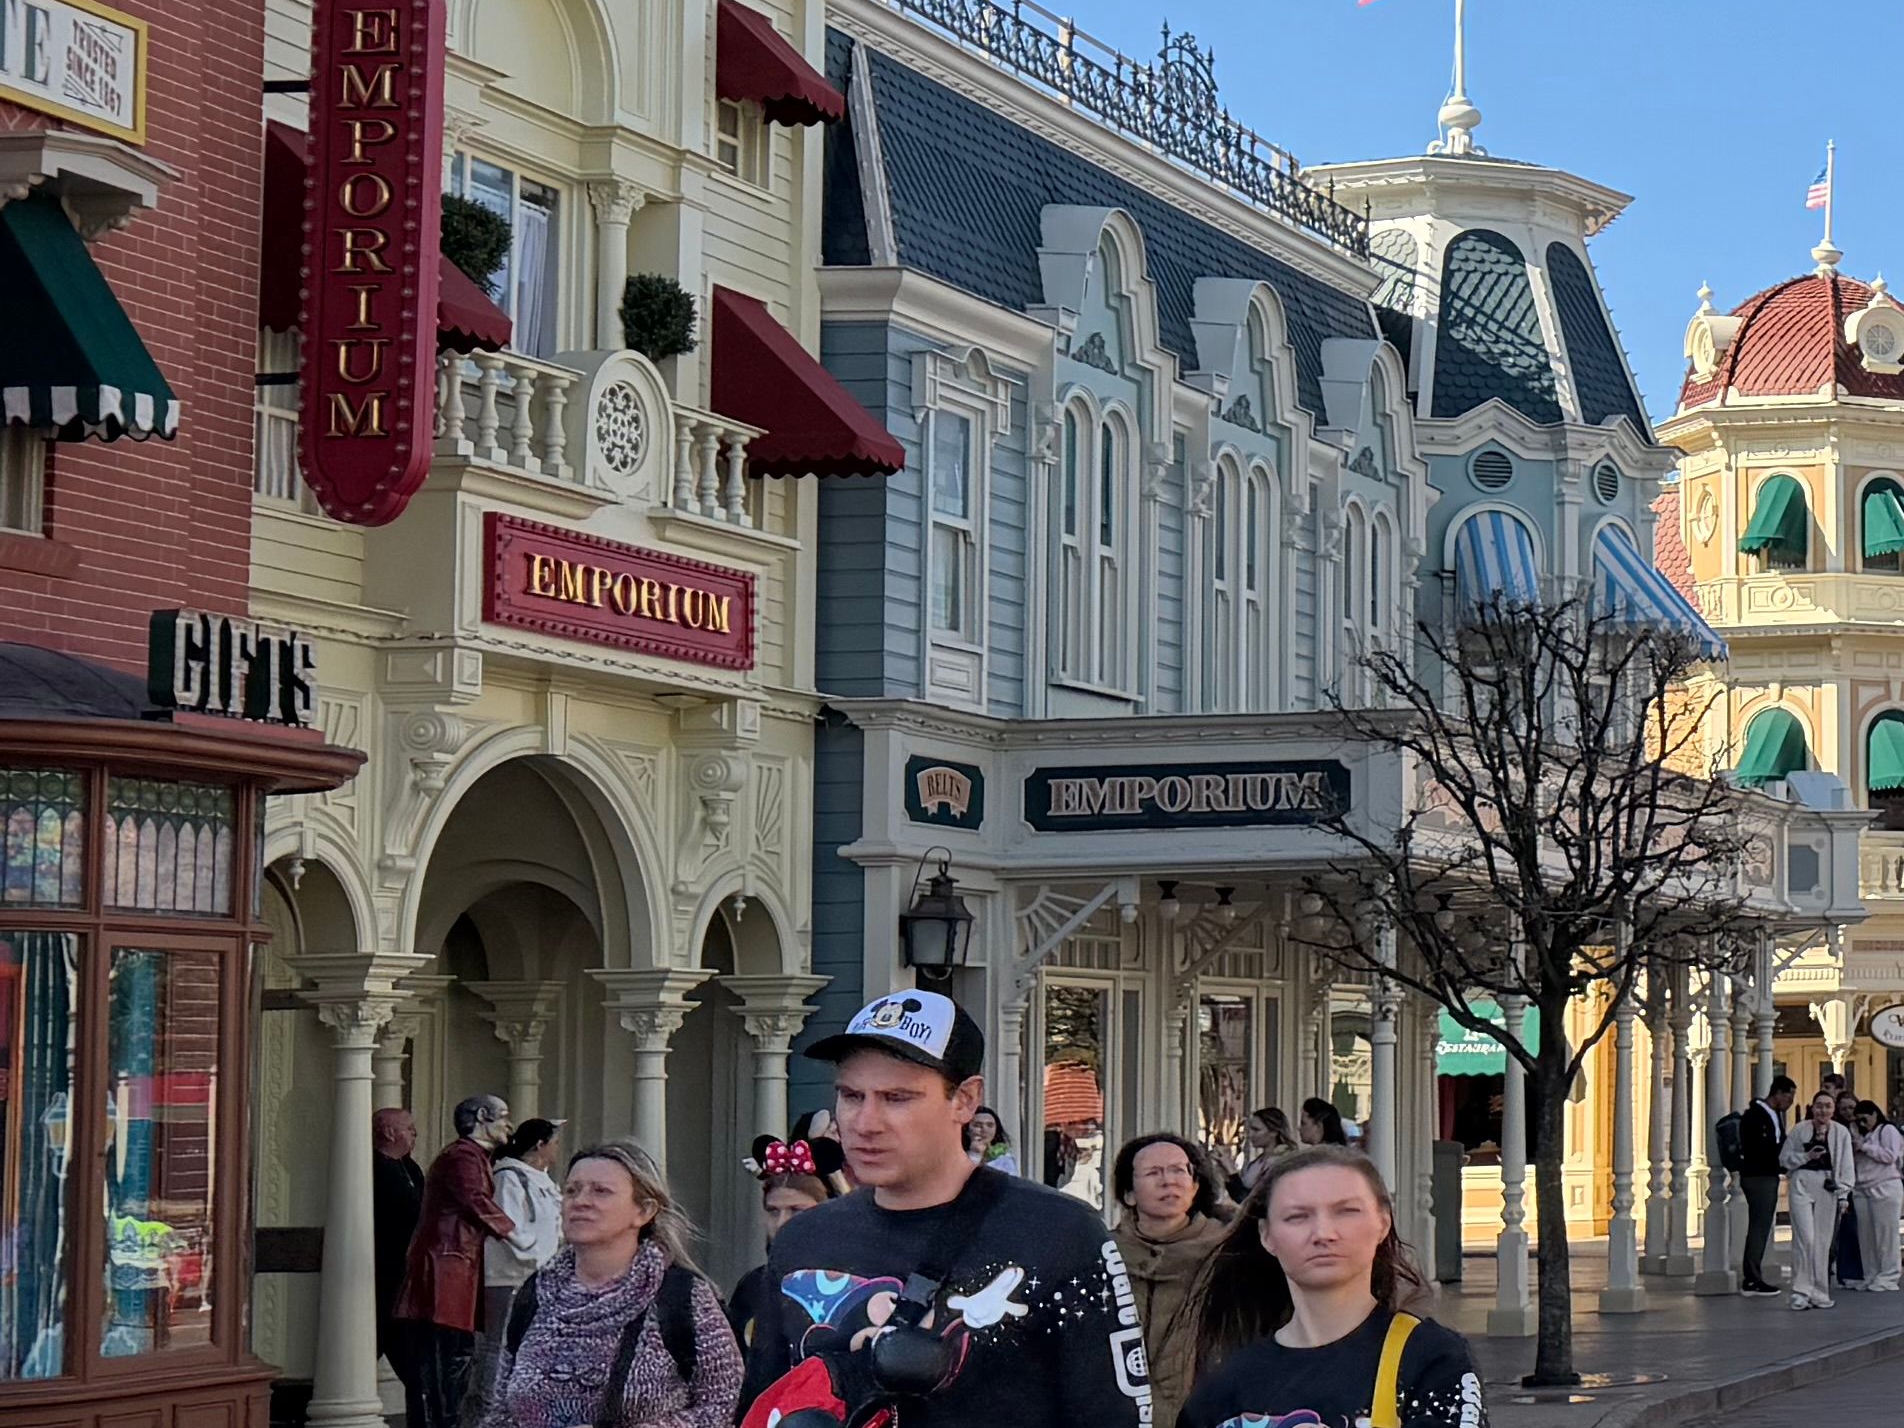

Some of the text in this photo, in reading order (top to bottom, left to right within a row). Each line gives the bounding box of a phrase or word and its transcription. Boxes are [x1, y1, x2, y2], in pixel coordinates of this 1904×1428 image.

[66, 45, 96, 93] SINCE
[72, 18, 118, 82] TRUSTED
[323, 7, 401, 439] EMPORIUM
[525, 552, 732, 635] EMPORIUM
[172, 607, 320, 723] GIFTS
[926, 772, 962, 801] BELTS
[1046, 772, 1325, 817] EMPORIUM
[1435, 1040, 1507, 1055] RESTAURAN
